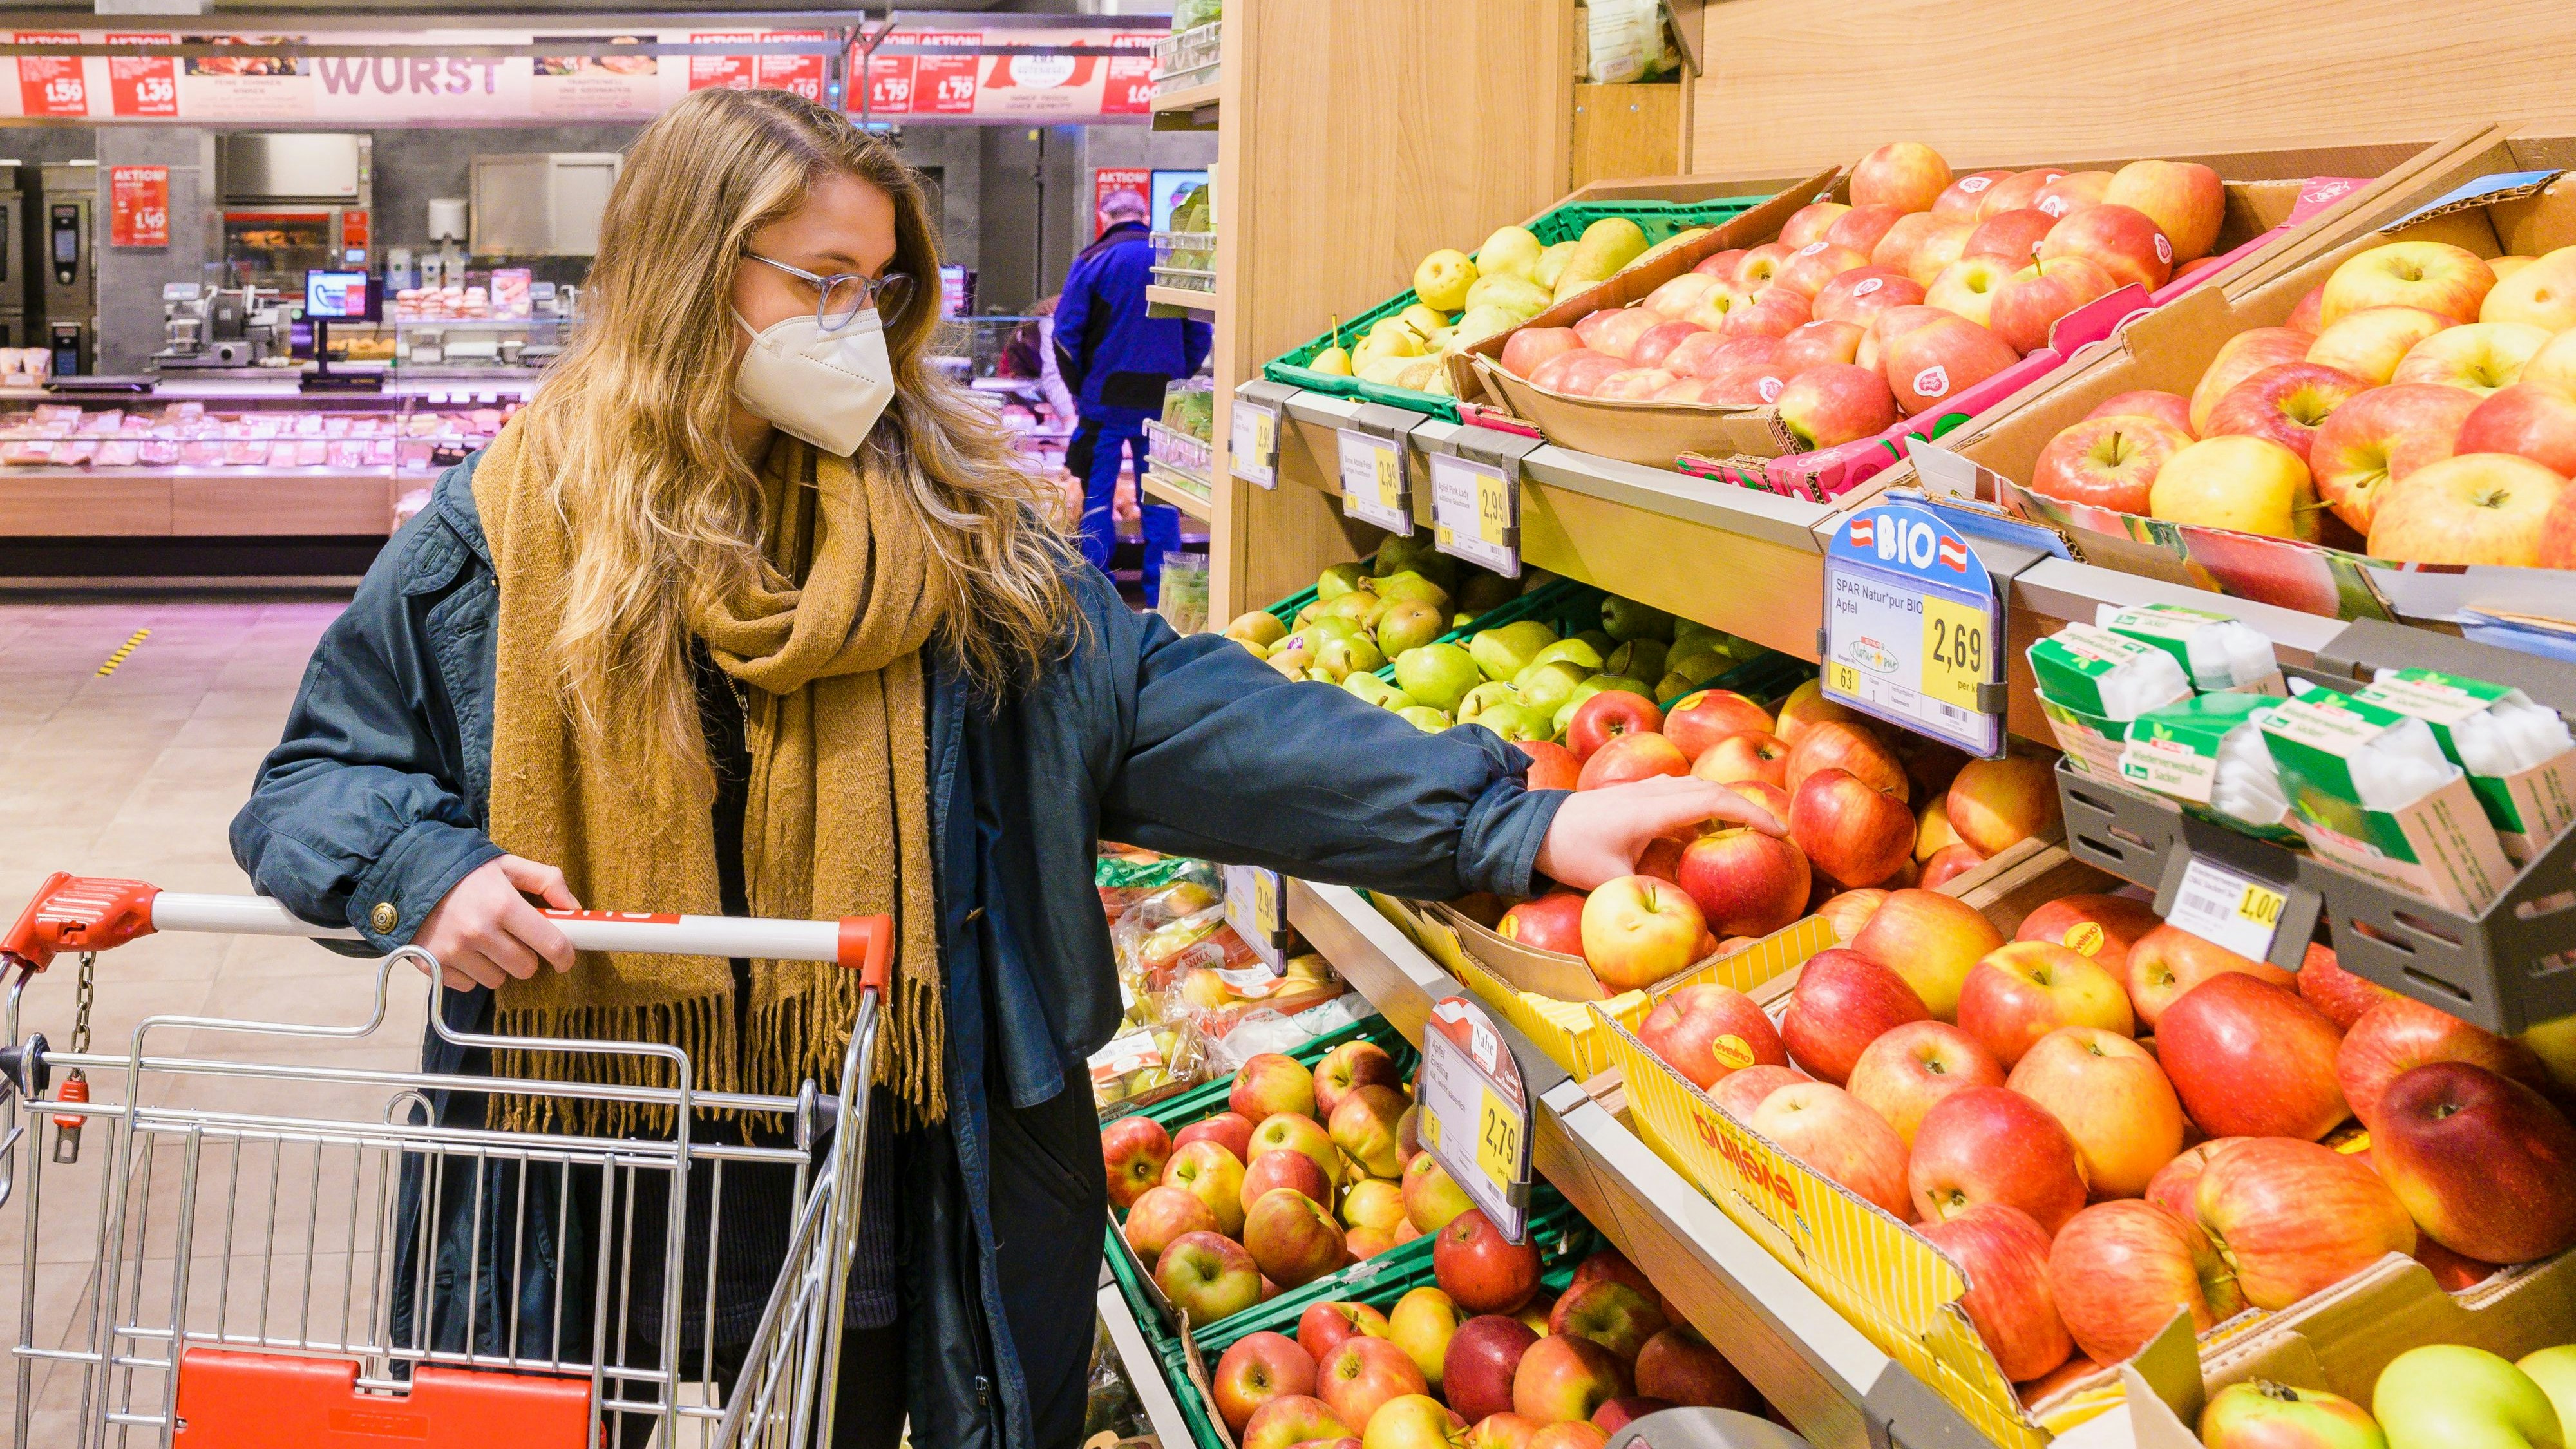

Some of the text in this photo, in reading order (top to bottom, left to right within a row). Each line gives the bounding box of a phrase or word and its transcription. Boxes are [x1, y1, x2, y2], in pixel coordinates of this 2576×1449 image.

[318, 57, 505, 95] WURST
[1877, 514, 1936, 569] BIO
[1835, 597, 1857, 614] Apfel
[1836, 578, 1861, 596] SPAR
[1907, 598, 1924, 614] BIO
[1933, 618, 1982, 673] 2,69
[1841, 668, 1853, 690] 63
[1957, 680, 1969, 695] per
[1872, 690, 1876, 703] 1
[2240, 888, 2281, 923] 1,00
[2074, 926, 2098, 949] velina
[1185, 951, 1212, 968] SNACK
[1476, 1027, 1494, 1057] Nahe
[1715, 1043, 1750, 1063] evelina
[1486, 1108, 1514, 1165] 2,79
[1692, 1111, 1798, 1211] evelina
